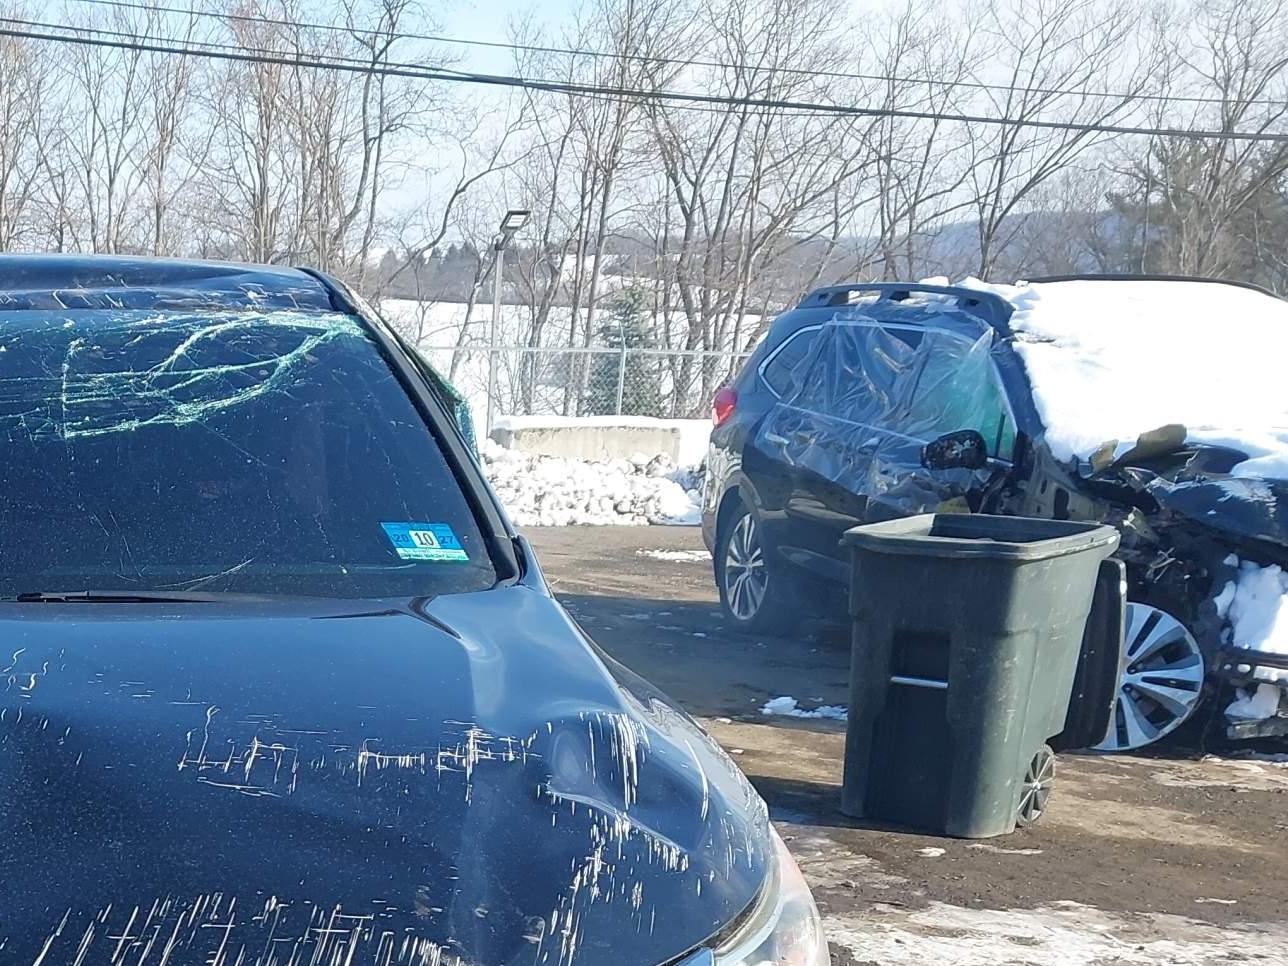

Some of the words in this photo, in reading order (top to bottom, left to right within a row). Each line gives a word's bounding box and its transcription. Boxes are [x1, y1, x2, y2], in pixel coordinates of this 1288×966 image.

[392, 533, 410, 543] 20
[414, 532, 435, 546] 10
[438, 535, 454, 545] 27
